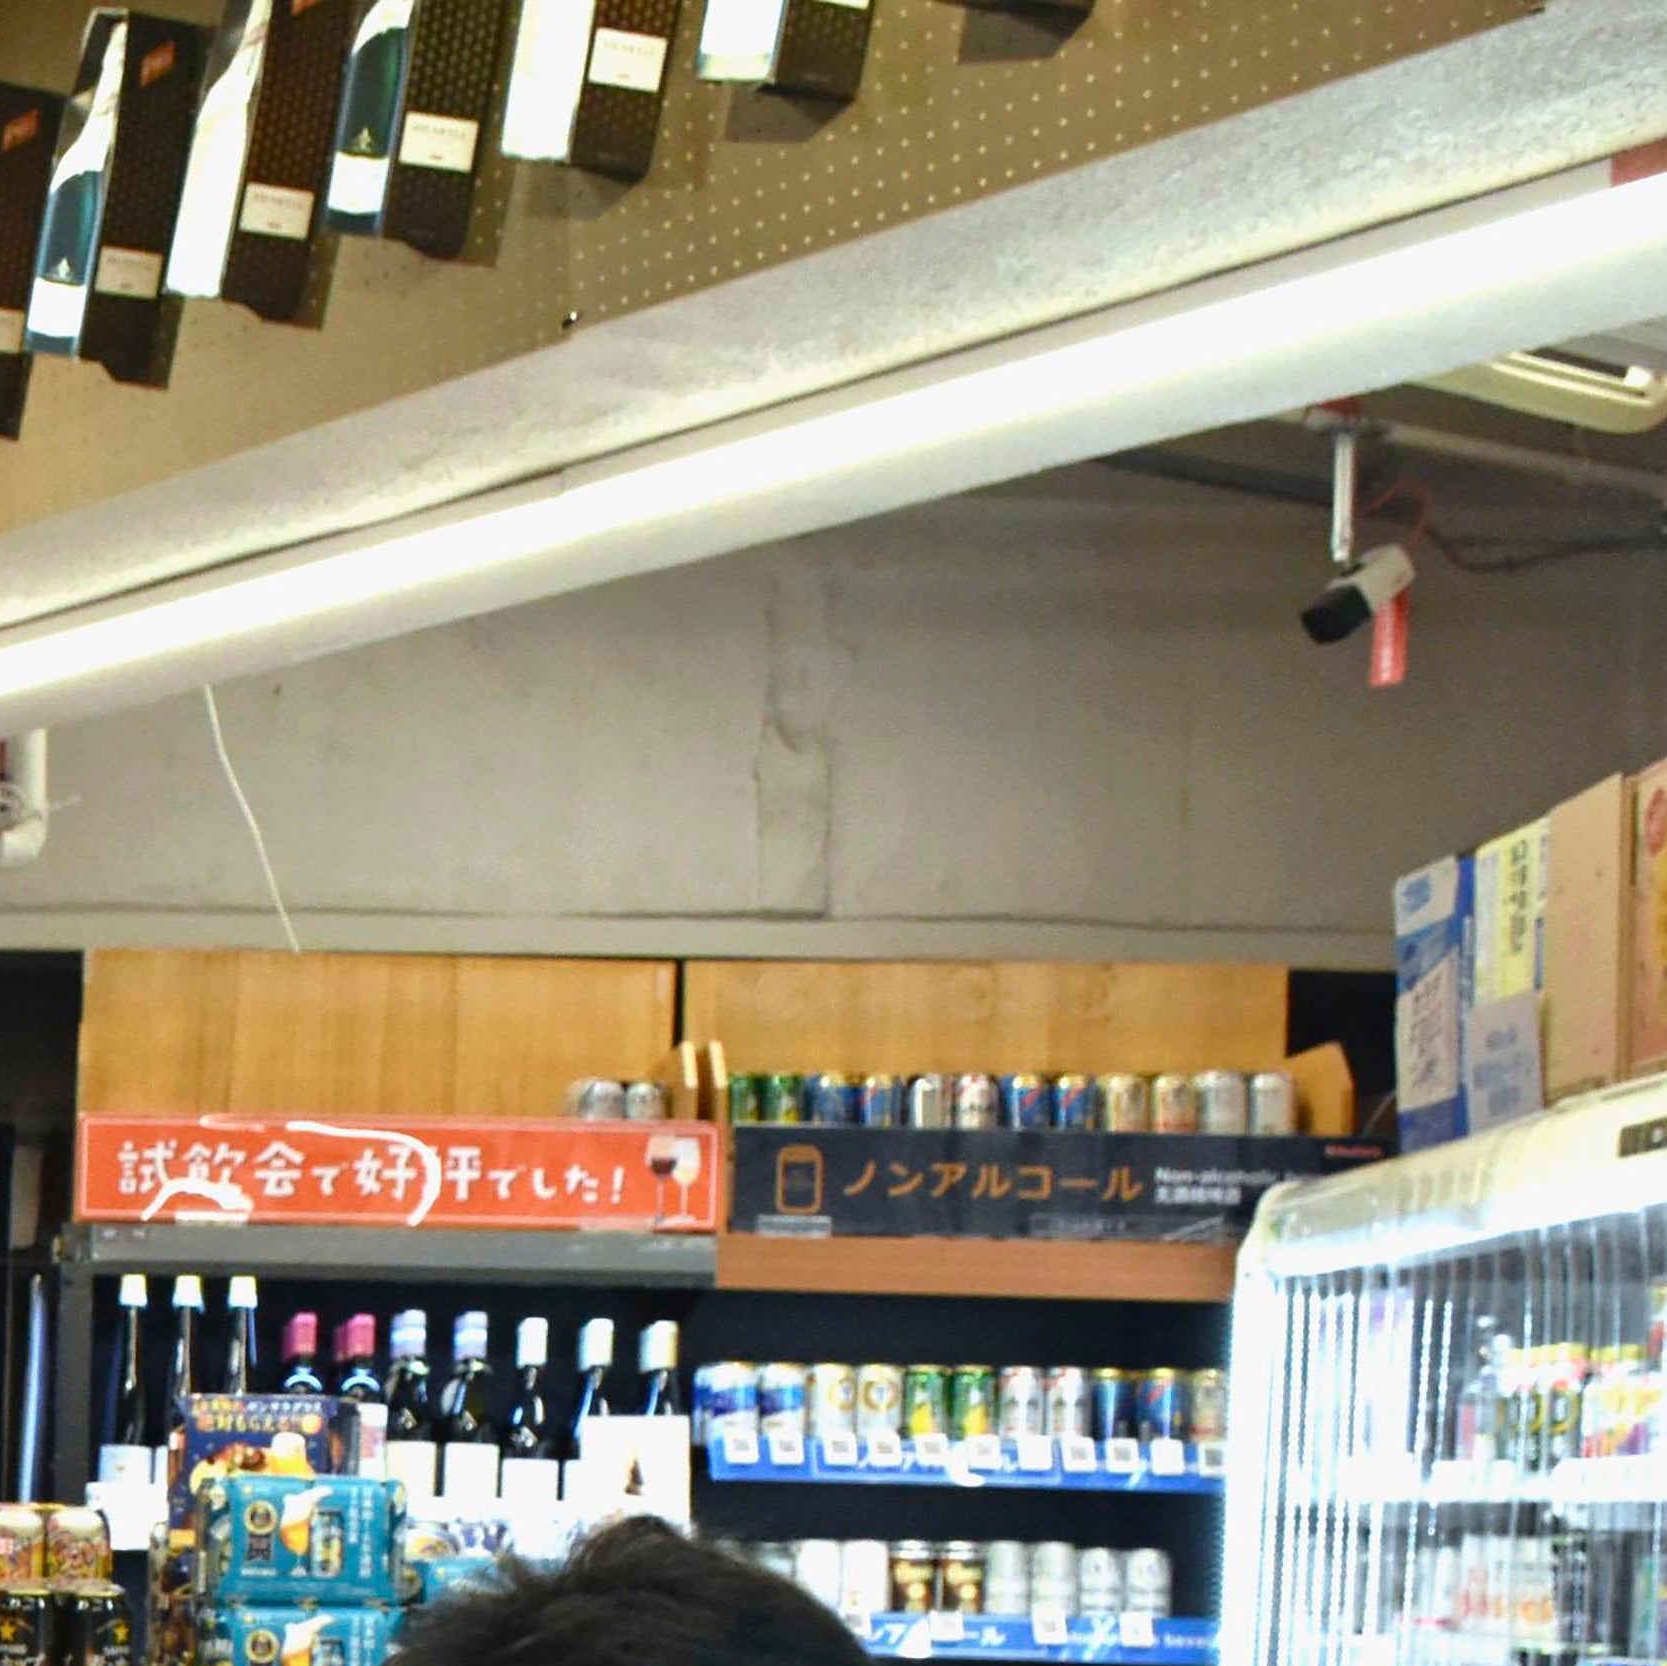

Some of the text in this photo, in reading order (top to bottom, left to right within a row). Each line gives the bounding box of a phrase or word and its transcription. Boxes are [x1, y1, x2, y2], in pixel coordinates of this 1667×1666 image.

[843, 1162, 1142, 1201] ノンアルコール
